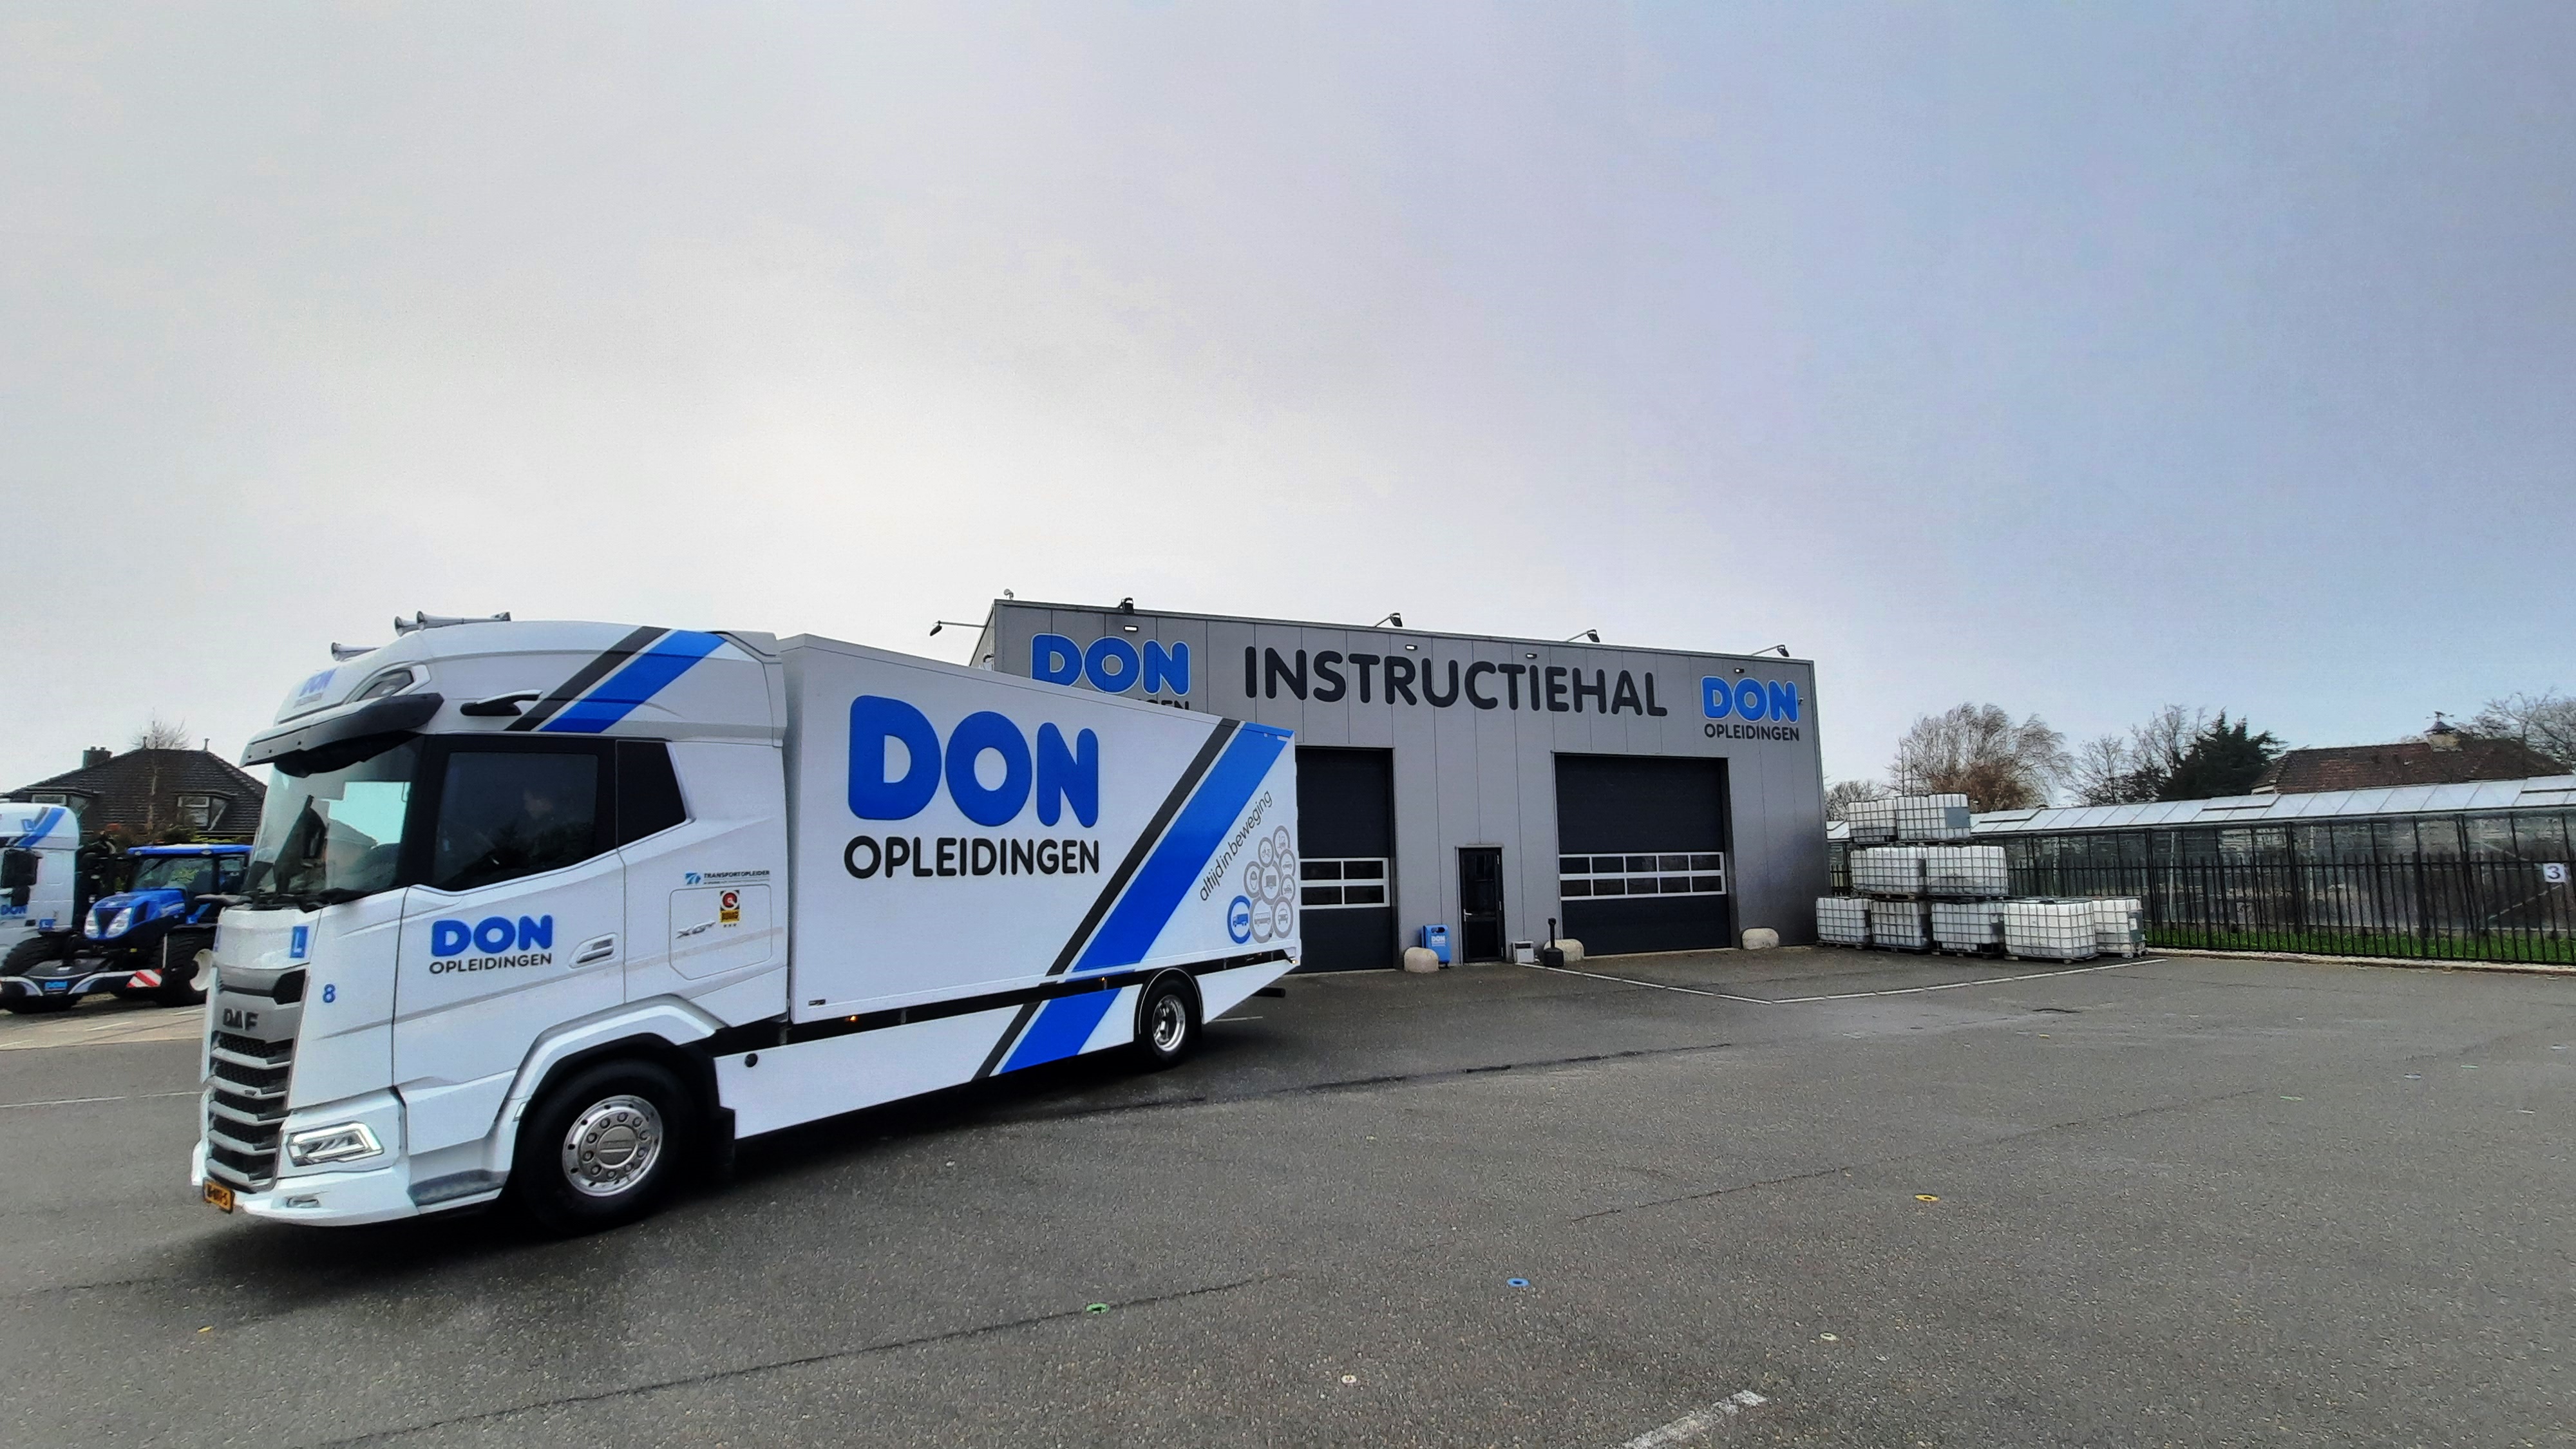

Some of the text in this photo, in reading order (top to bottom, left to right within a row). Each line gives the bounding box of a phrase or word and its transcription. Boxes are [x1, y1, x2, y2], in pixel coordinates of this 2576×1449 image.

[1030, 633, 1190, 696] DON
[1244, 645, 1668, 717] INSTRUCTIEHAL
[1701, 676, 1799, 723] DON
[1704, 723, 1800, 742] OPLEIDINGEN
[848, 694, 1099, 829] DON
[844, 835, 1099, 880] OPLEIDINGEN
[1200, 790, 1273, 902] altijd in beweging
[2547, 866, 2561, 880] 3
[431, 914, 554, 957] DON
[429, 952, 553, 974] OPLEIDINGEN
[323, 983, 336, 1003] 8
[223, 1008, 259, 1030] DAF
